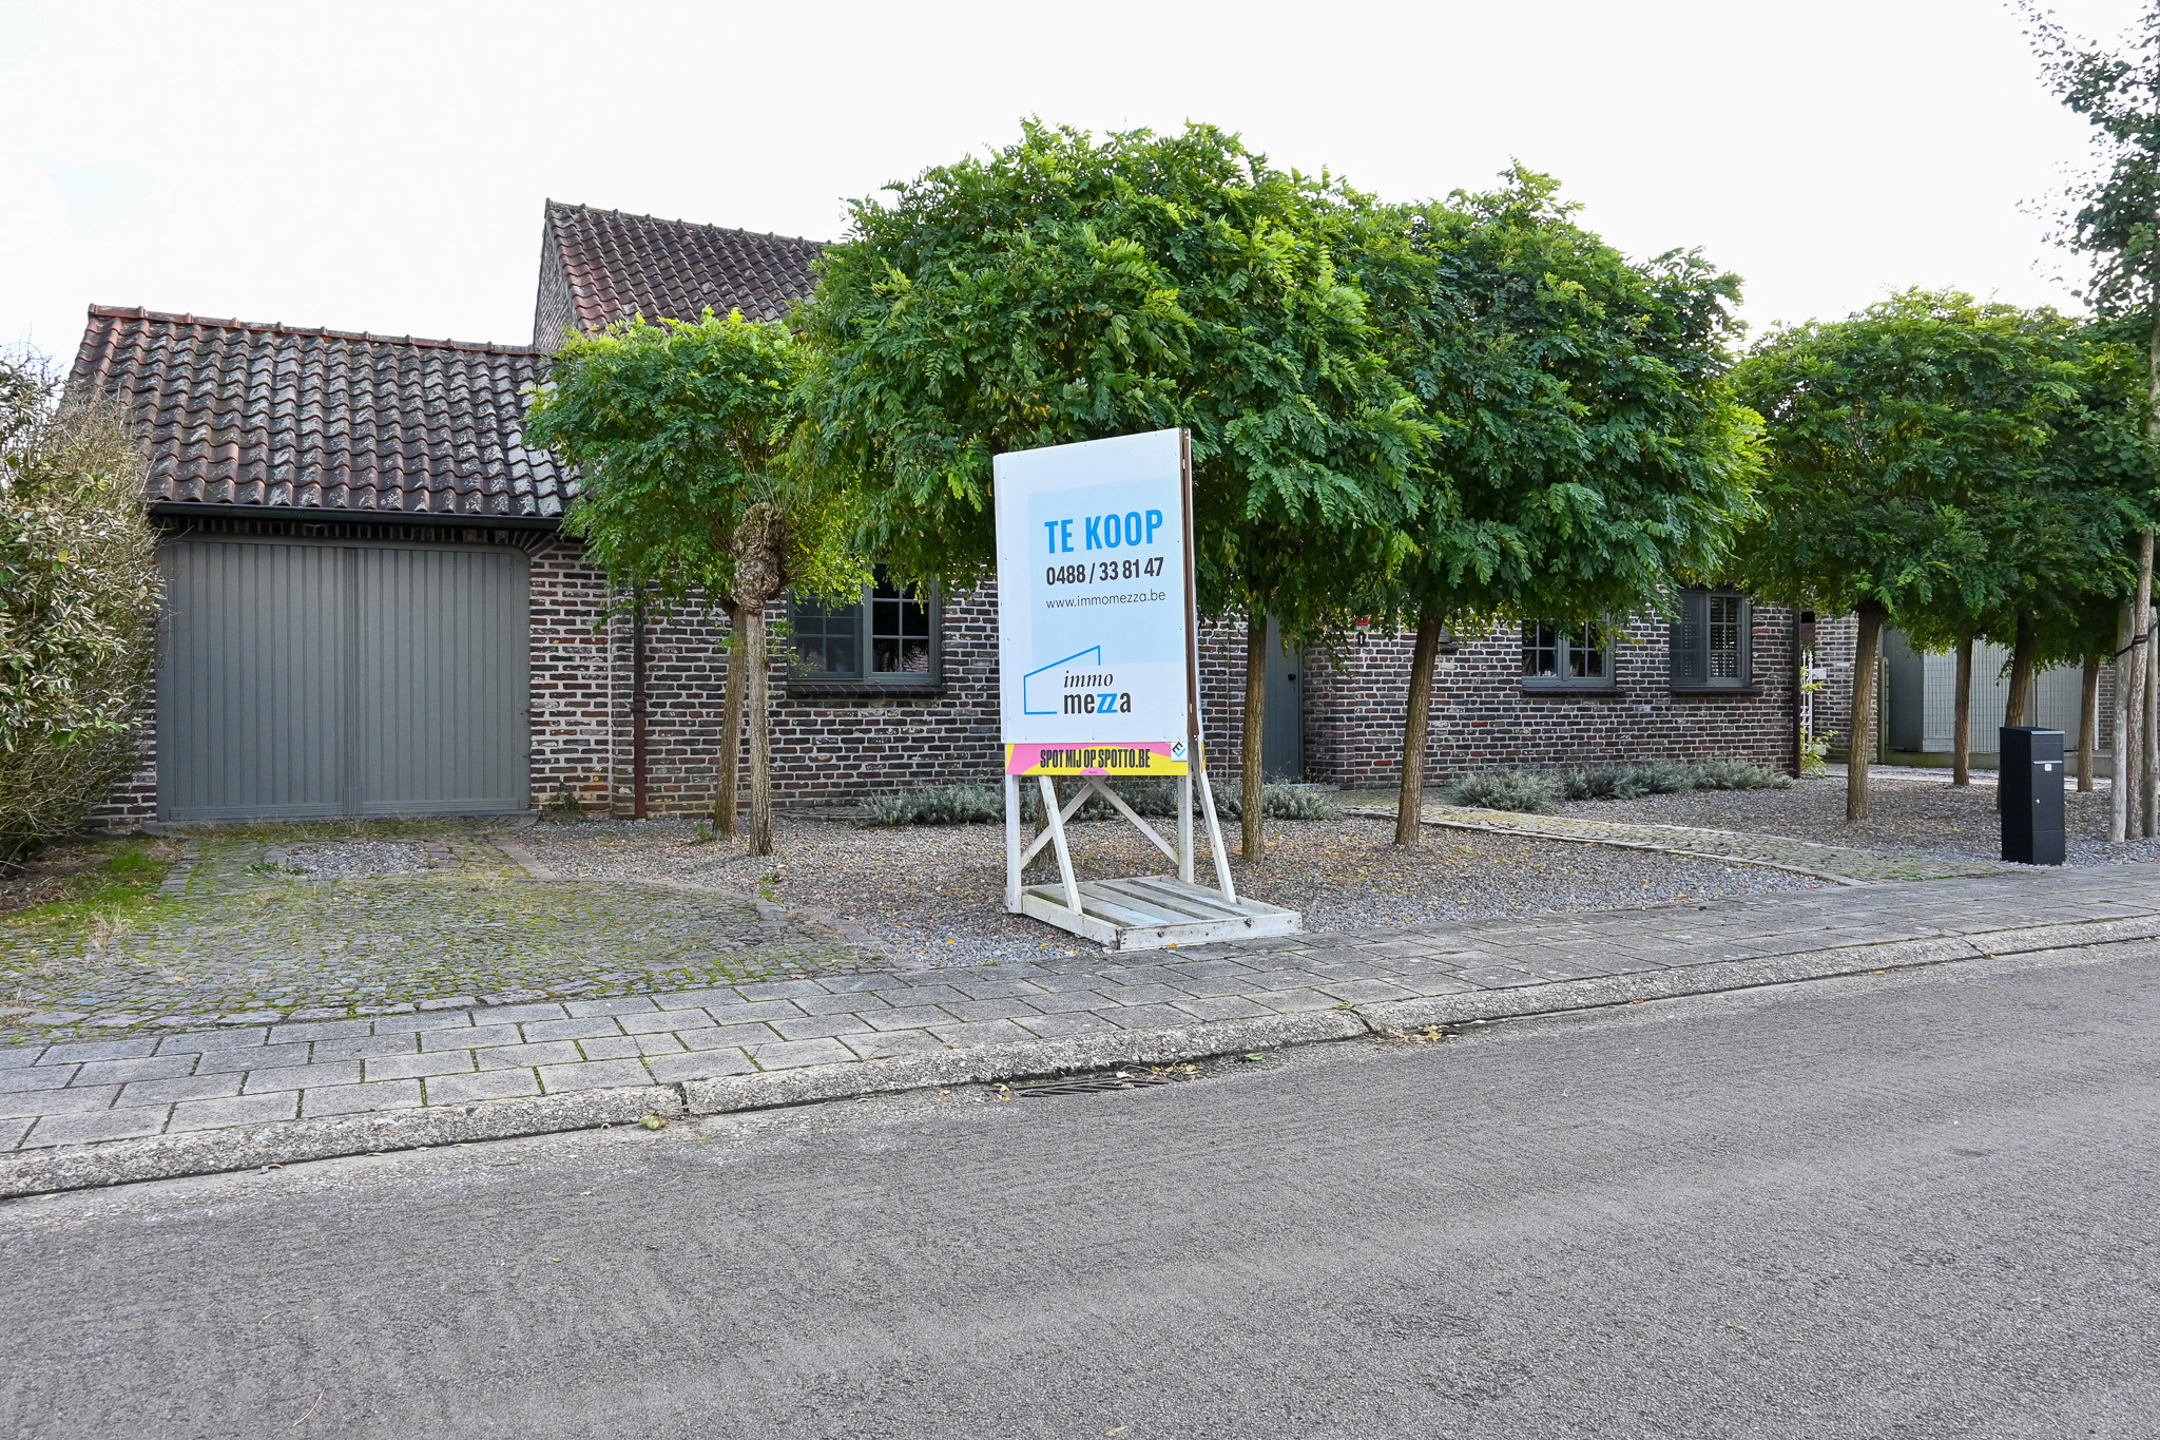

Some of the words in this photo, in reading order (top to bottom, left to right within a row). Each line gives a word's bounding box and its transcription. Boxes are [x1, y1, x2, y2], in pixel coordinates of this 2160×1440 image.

[1044, 519, 1074, 554] TE
[1085, 509, 1163, 550] KOOP
[1046, 563, 1086, 586] 0488
[1089, 562, 1096, 584] /
[1099, 560, 1119, 581] 33
[1122, 558, 1140, 579] 81
[1143, 556, 1164, 577] 47
[1046, 588, 1166, 609] www.immomezza.be
[1064, 670, 1114, 688] immo
[1063, 692, 1132, 714] mezza
[1040, 749, 1064, 768] SPOT
[1065, 749, 1082, 768] MIJ
[1083, 749, 1097, 768] OP
[1098, 748, 1151, 768] SPOTTO.BE
